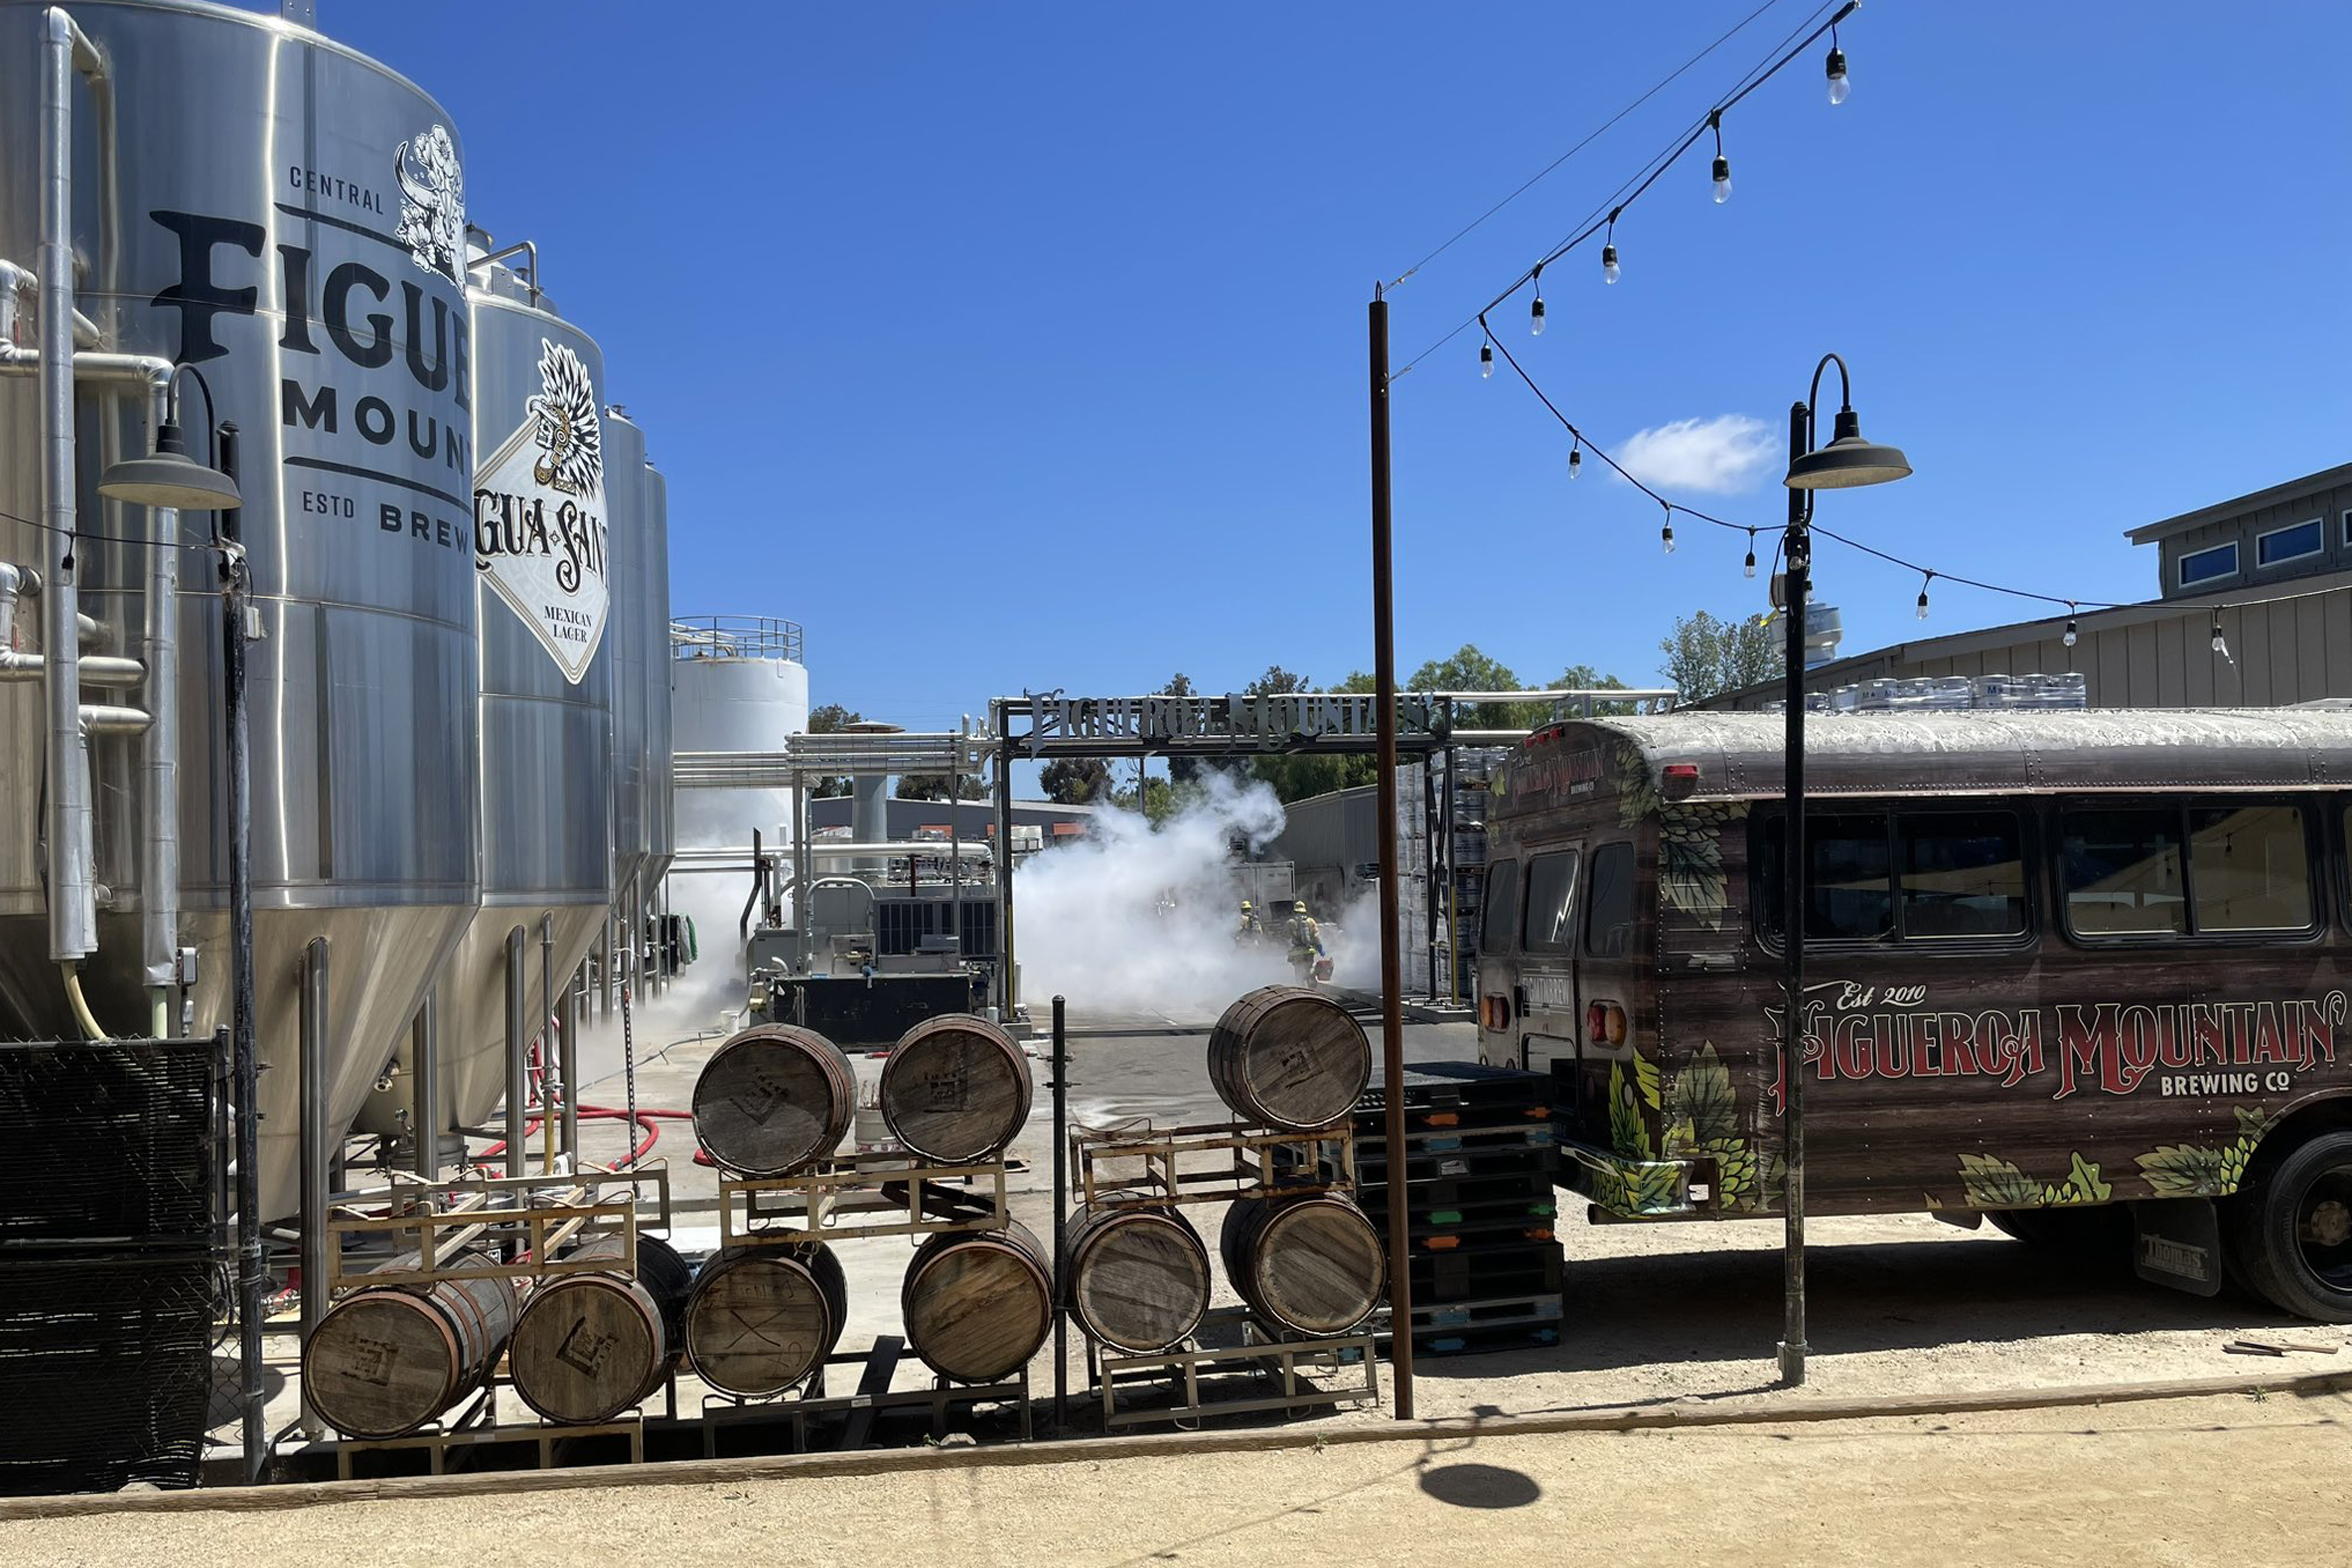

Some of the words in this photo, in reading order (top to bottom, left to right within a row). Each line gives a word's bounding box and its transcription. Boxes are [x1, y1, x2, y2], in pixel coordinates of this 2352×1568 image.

[289, 165, 384, 216] CENTRAL
[281, 378, 471, 476] MOUN
[303, 491, 355, 519] ESTD
[379, 503, 468, 555] BREW
[544, 605, 593, 628] MEXICAN
[553, 624, 588, 643] LAGER
[1222, 689, 1434, 755] MOUNTAN
[1836, 982, 1876, 1011] Est
[1880, 984, 1928, 1007] 2010
[2052, 989, 2348, 1101] MOUNTAIN
[2160, 1072, 2260, 1097] BREWING
